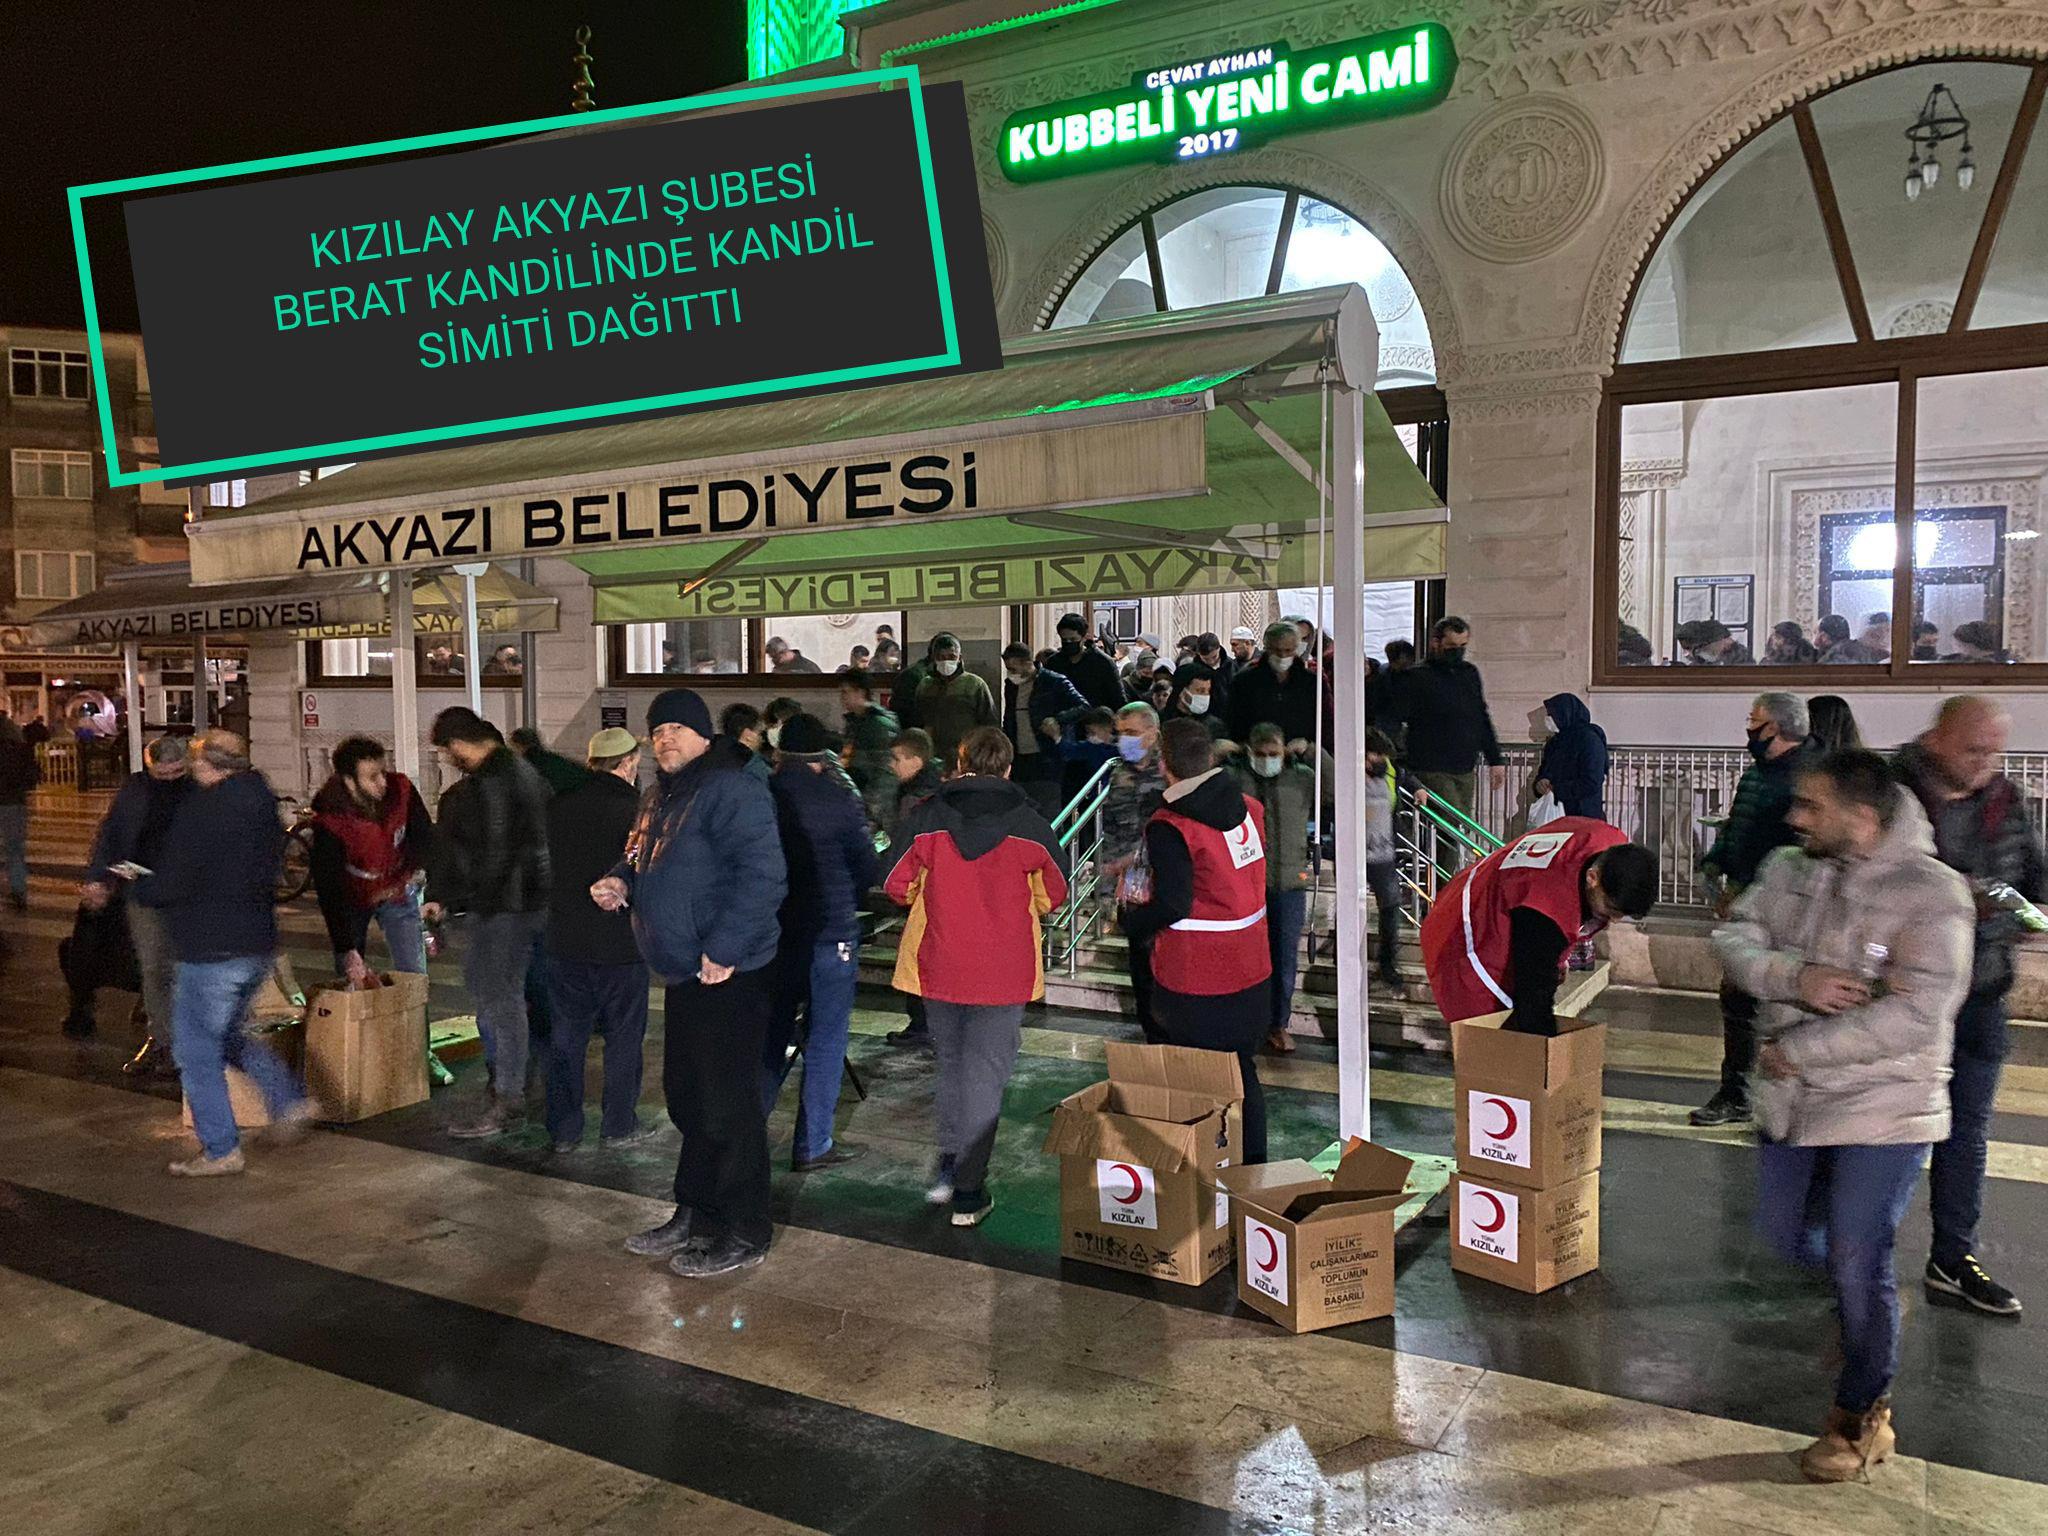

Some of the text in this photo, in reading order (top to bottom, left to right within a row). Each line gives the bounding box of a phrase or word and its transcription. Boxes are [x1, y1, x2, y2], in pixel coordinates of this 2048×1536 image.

[1147, 48, 1273, 89] CEVAT AYHAN
[1010, 31, 1429, 162] KUBBELİ YENİ CAMİ
[1179, 127, 1238, 156] 2017
[297, 506, 493, 570] AKYAZI
[76, 617, 156, 642] AKYAZI
[1481, 1147, 1518, 1162] KIZILAY
[1111, 1212, 1146, 1225] KIZILAY
[1470, 1238, 1506, 1256] KIZILAY
[1254, 1276, 1280, 1298] KIZILAY
[1320, 1267, 1369, 1284] TOPLUMUN
